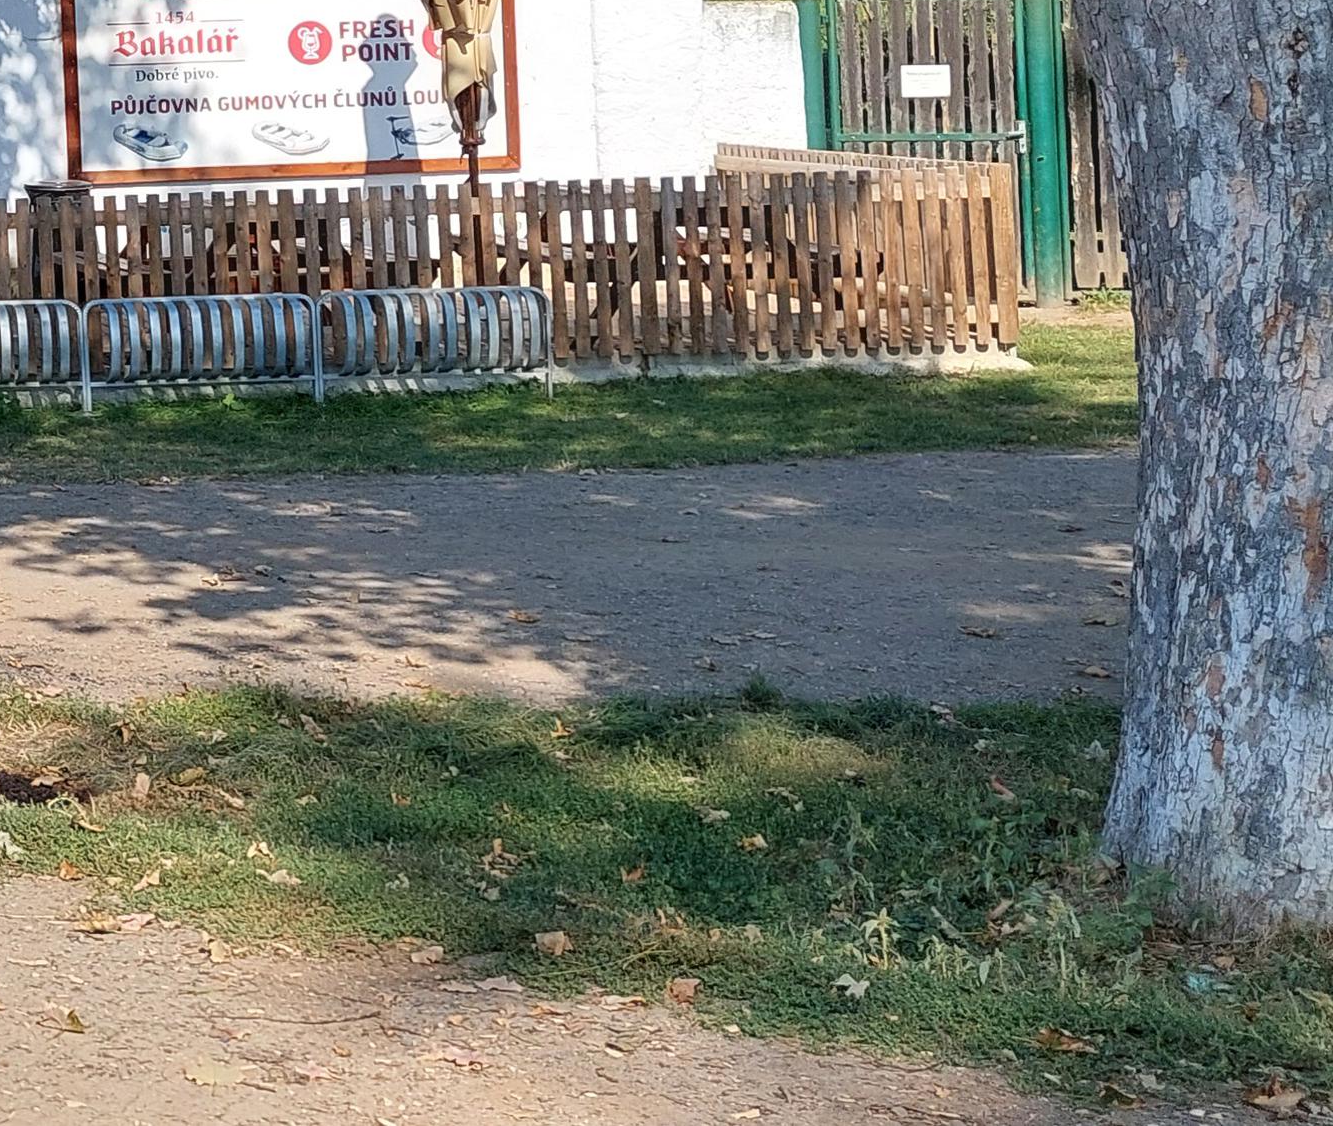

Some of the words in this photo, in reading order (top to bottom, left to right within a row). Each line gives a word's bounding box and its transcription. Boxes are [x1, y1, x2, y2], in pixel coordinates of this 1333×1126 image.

[155, 10, 195, 24] 1454
[339, 19, 414, 39] FRESH
[113, 28, 239, 57] Bakalář
[341, 42, 414, 62] POINT
[135, 67, 180, 82] Dobré
[183, 67, 219, 83] pivo.
[111, 94, 212, 115] PŮJČOVNA
[218, 90, 327, 112] GUMOVÝCH
[333, 86, 397, 108] ČLUNŮ
[402, 89, 446, 106] LOU
